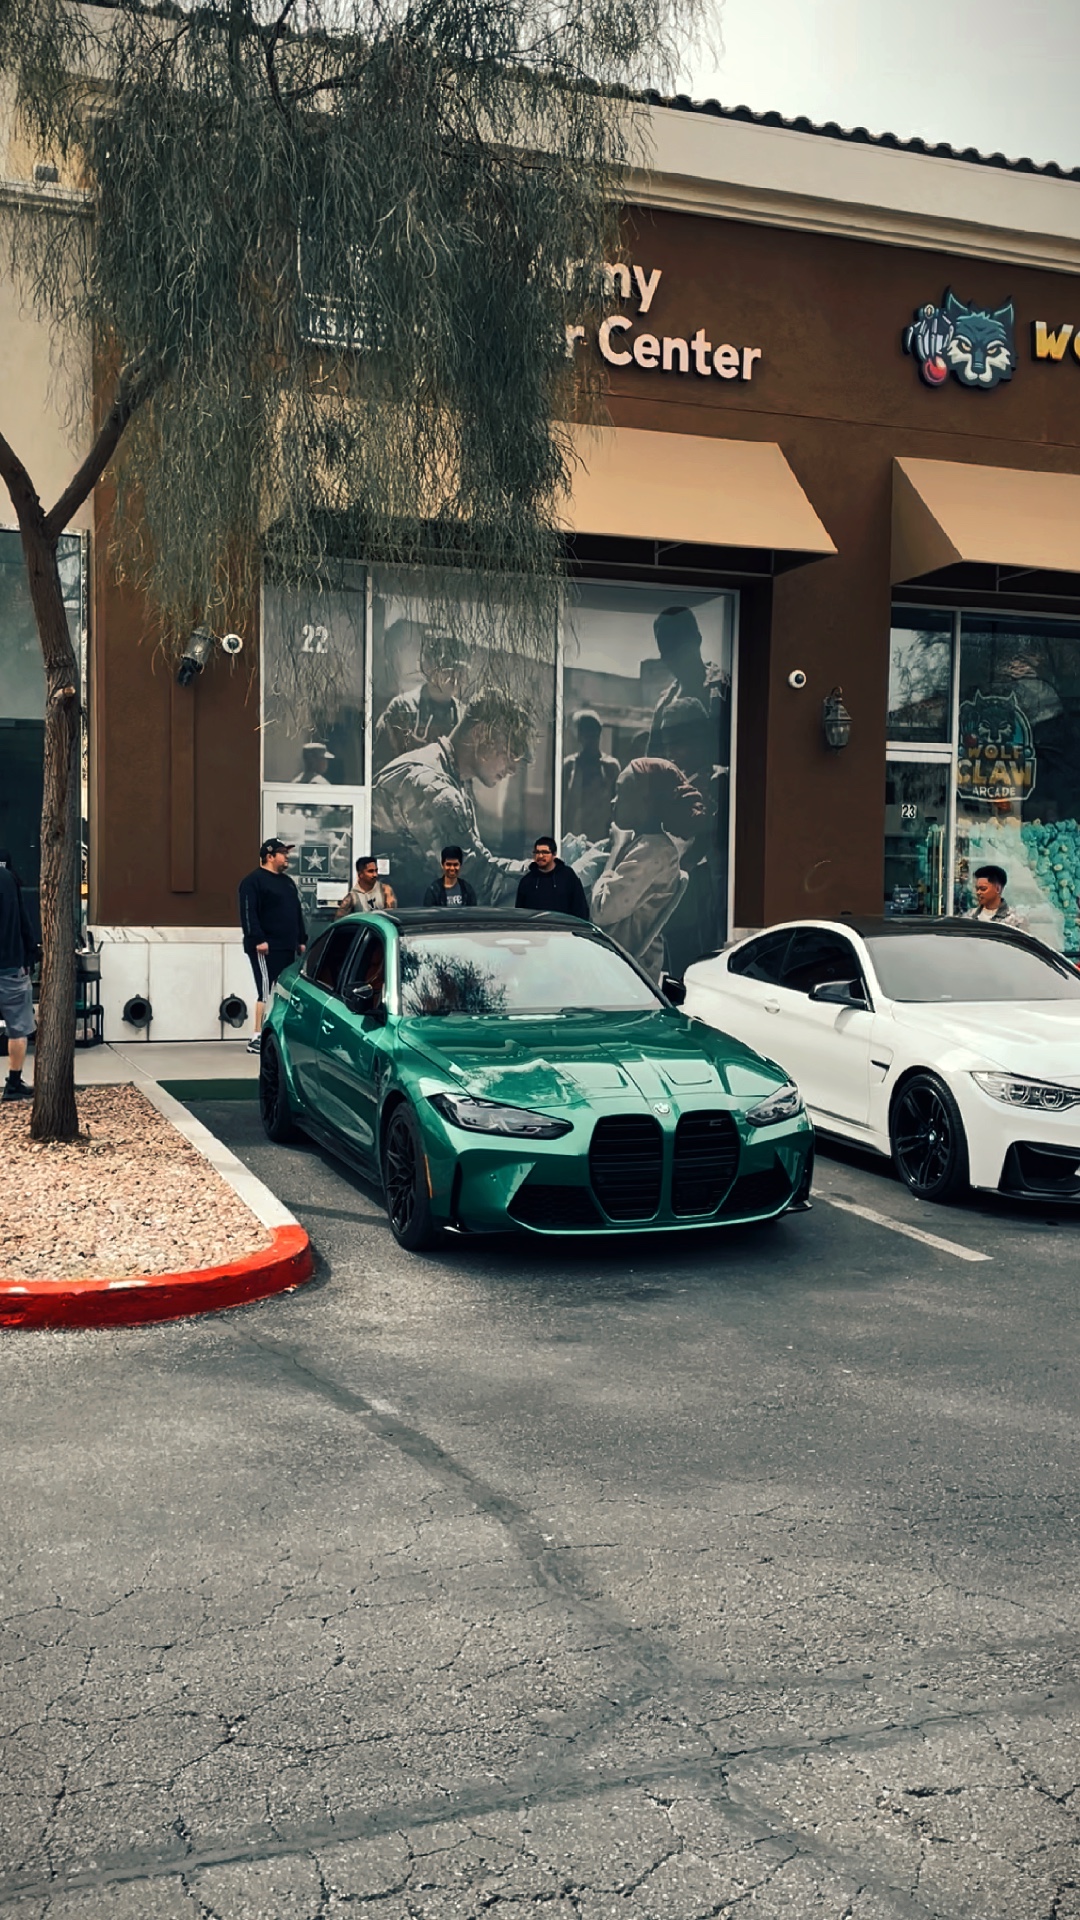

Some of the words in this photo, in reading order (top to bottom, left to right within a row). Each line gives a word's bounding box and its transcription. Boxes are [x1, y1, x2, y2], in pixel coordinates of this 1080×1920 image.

[599, 315, 762, 380] Center
[302, 624, 328, 653] 22
[968, 744, 1023, 759] WOLF
[957, 759, 1032, 786] CLAW
[972, 786, 1016, 798] ARCADE
[902, 804, 916, 818] 23
